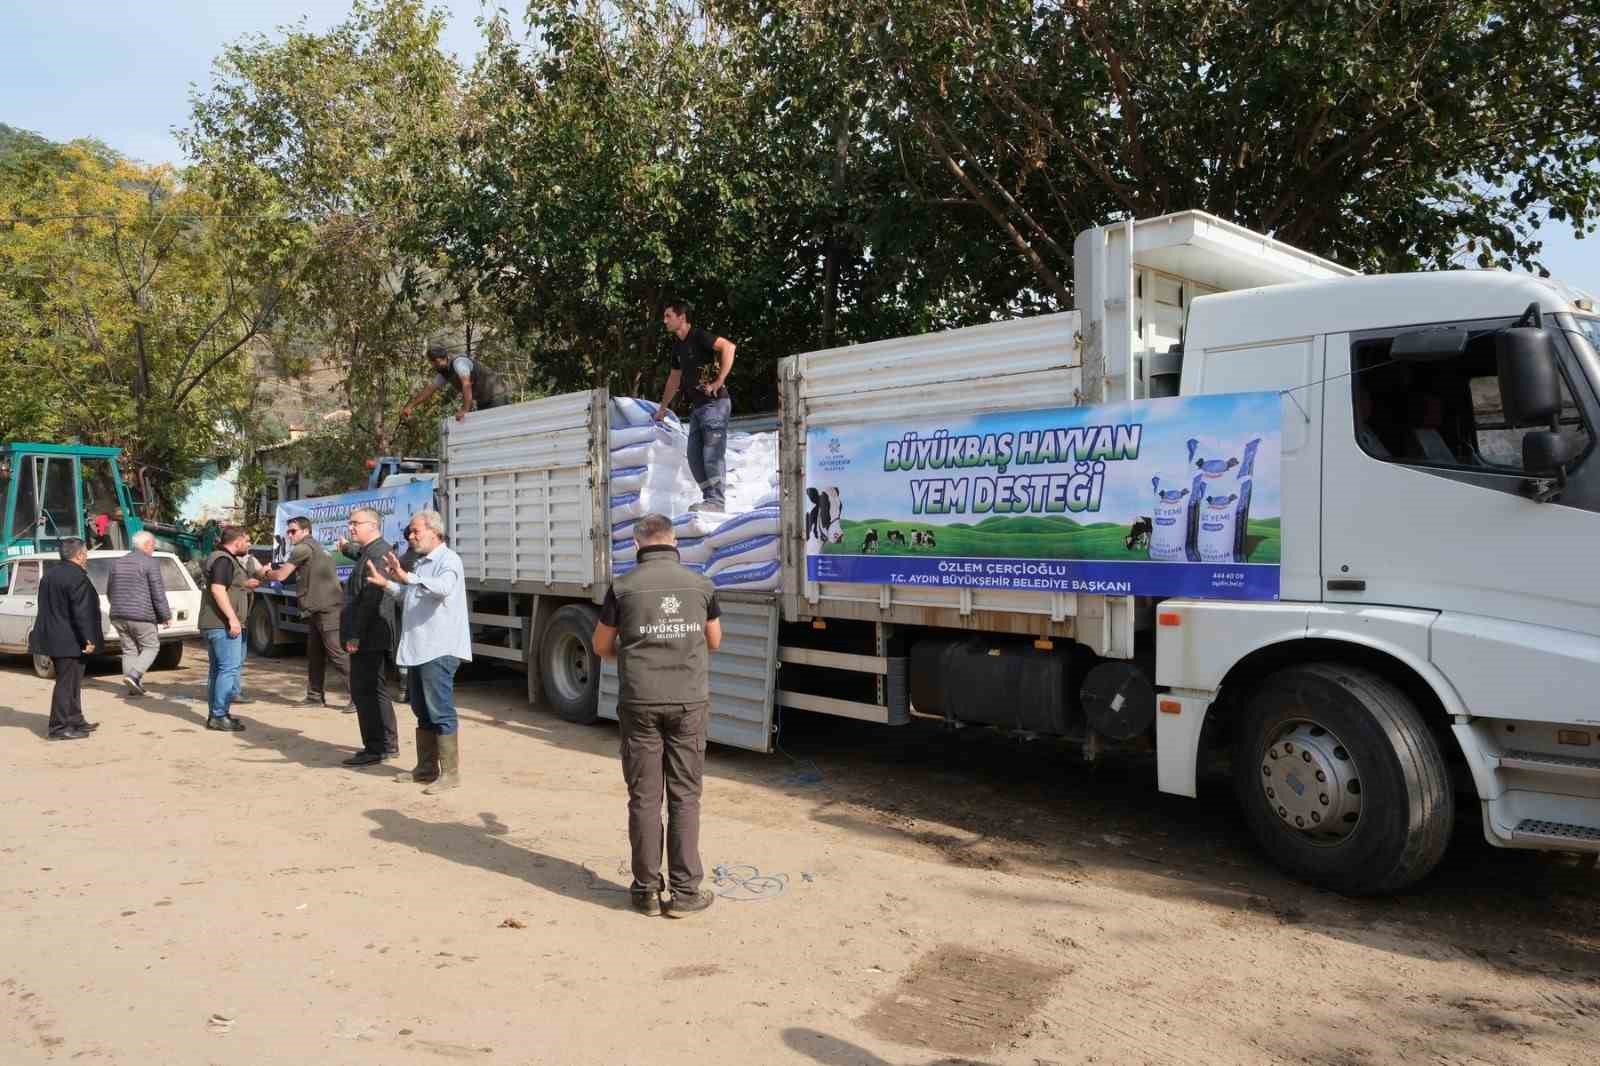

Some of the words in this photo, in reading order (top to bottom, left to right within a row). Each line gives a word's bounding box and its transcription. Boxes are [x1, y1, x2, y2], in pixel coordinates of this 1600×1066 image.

[884, 429, 1014, 474] BÜYÜKBAŞ
[1017, 424, 1142, 464] HAYVAN
[910, 478, 969, 515] YEM
[972, 461, 1105, 514] DESTEĞİ
[890, 573, 906, 583] T.C.
[909, 575, 940, 584] AYDIN
[942, 574, 1010, 588] BÜYÜKŞEHİR
[1013, 578, 1068, 590] BELEDİYE
[1072, 581, 1132, 593] BAŞKANI
[938, 560, 983, 573] ÖZLEM
[986, 562, 1066, 576] ÇERÇİOĞLU
